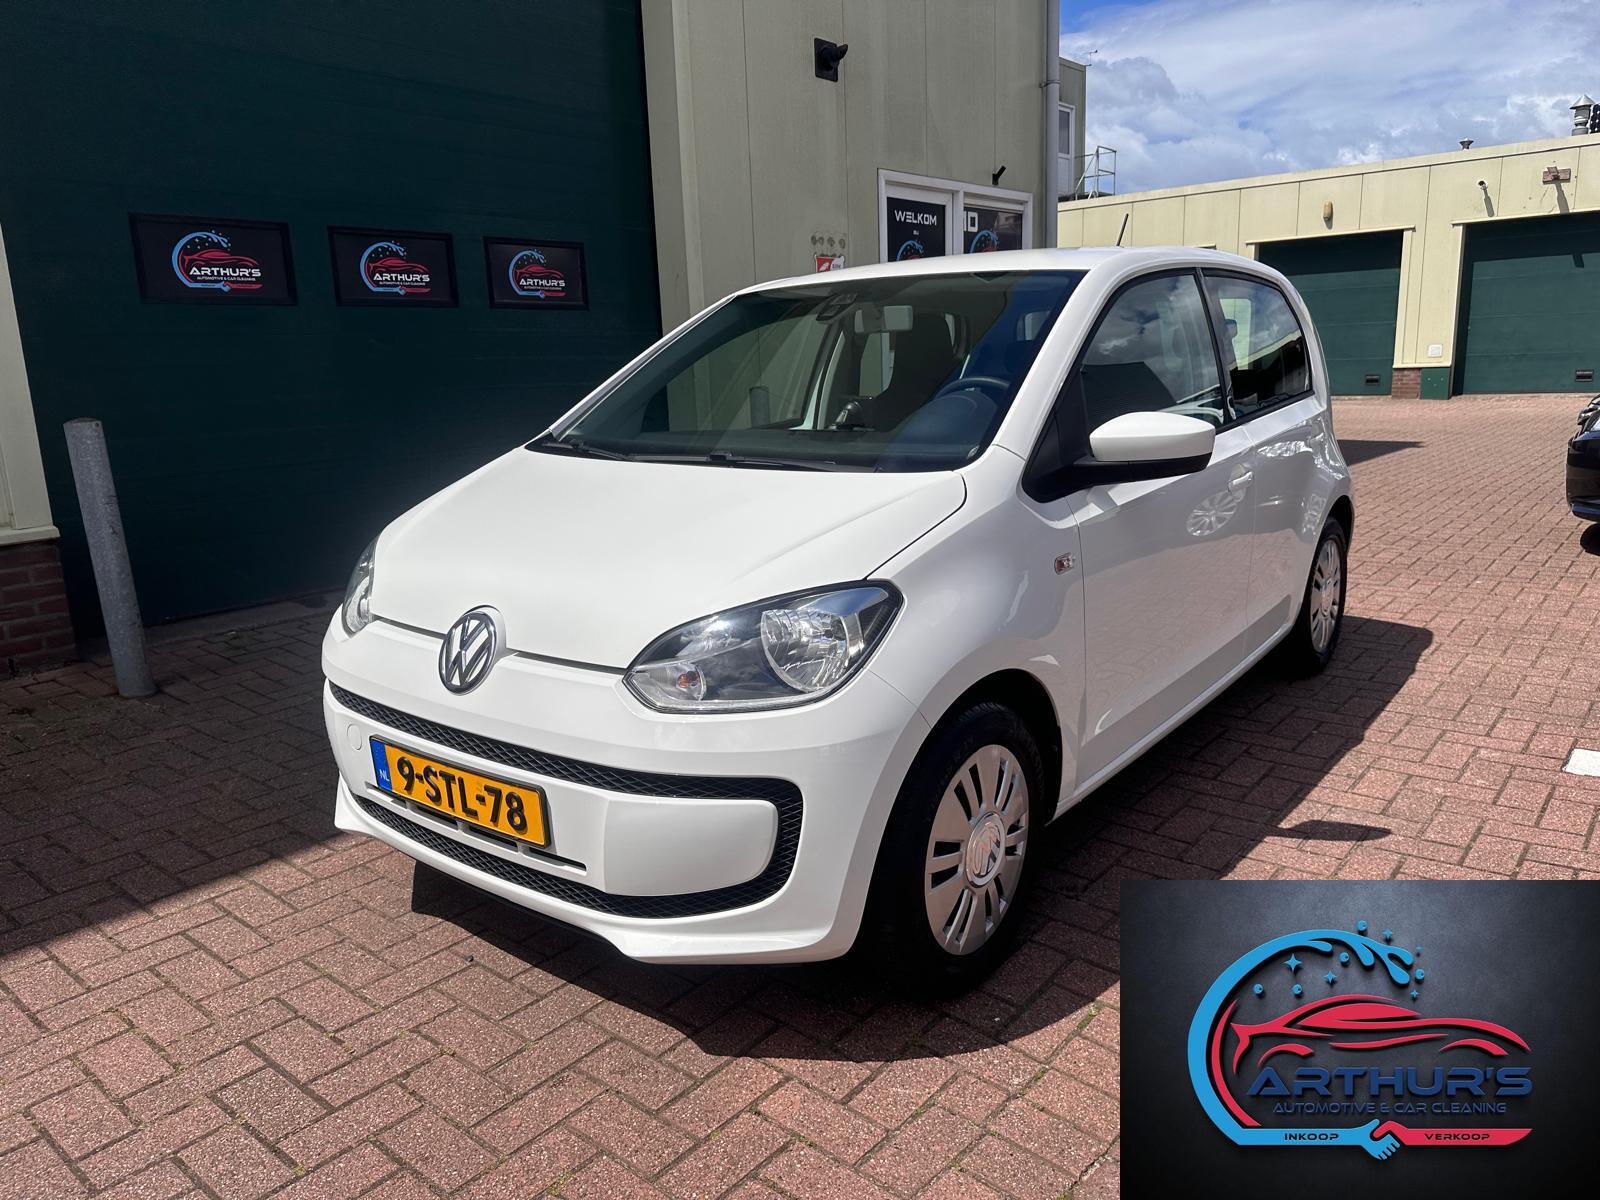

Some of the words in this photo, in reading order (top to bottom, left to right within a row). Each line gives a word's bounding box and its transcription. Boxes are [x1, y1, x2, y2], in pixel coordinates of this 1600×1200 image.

[894, 209, 937, 226] WELKOM
[189, 266, 261, 277] ARTHUR'S
[373, 273, 430, 282] ARTHUR'S
[379, 768, 390, 782] NL
[397, 756, 527, 831] 9-STL-78
